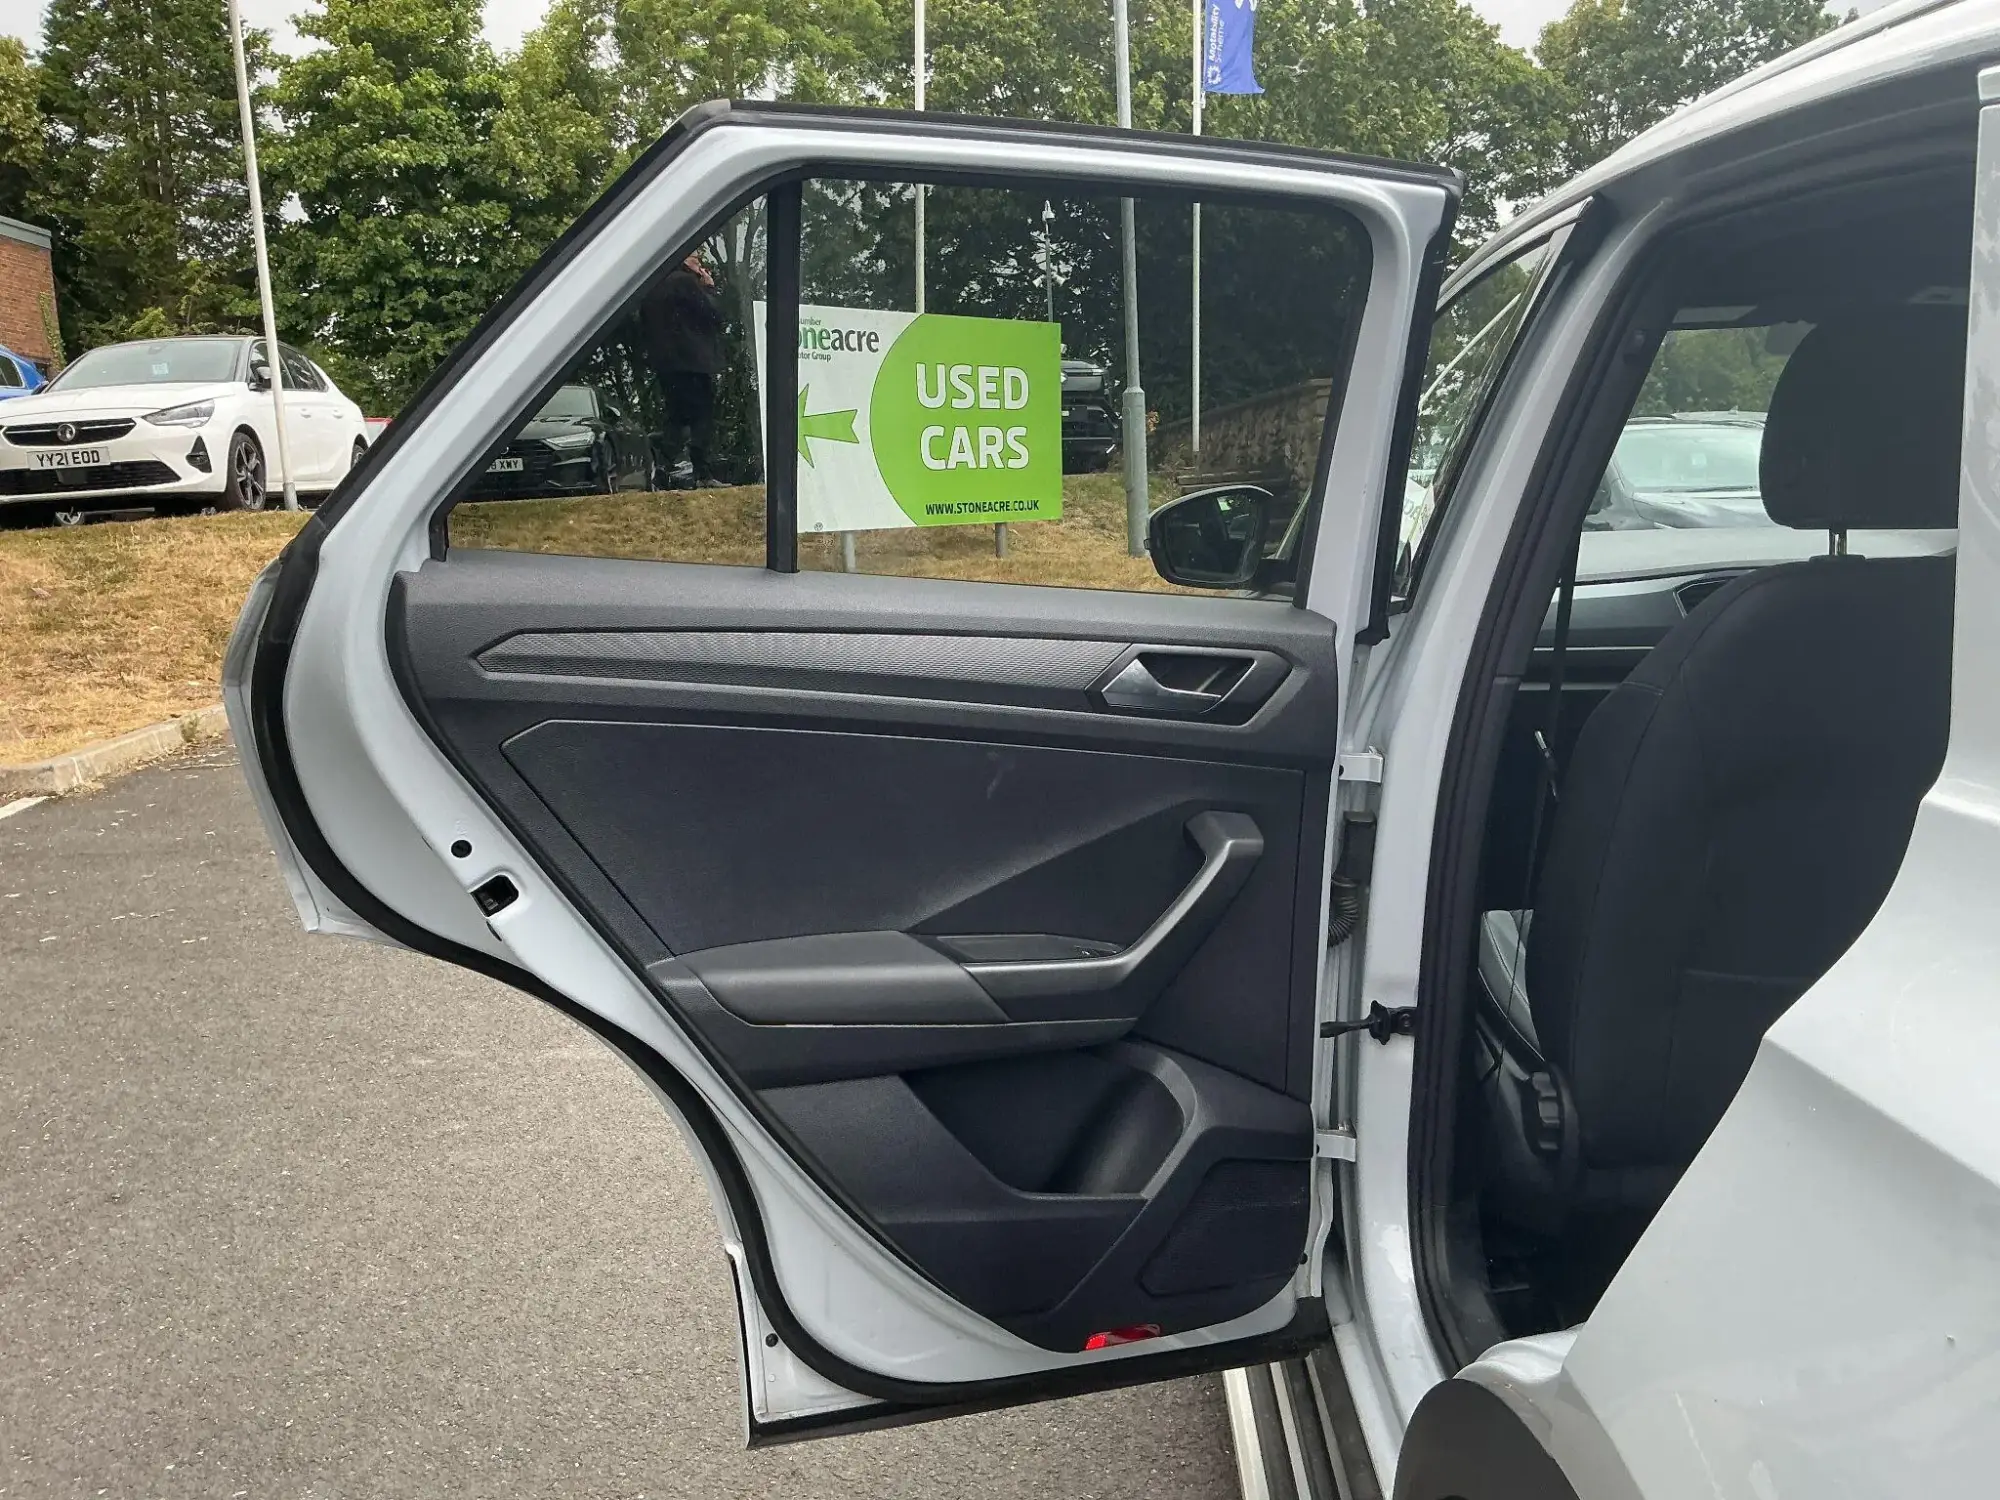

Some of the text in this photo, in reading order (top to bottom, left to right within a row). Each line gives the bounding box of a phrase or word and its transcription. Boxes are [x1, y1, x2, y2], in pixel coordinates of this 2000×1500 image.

[1208, 3, 1220, 62] Motability
[811, 351, 832, 363] Group
[915, 362, 1029, 410] USED
[36, 452, 69, 467] YY21
[919, 425, 1029, 471] CARS
[925, 499, 1040, 516] WWW.STONEACRE.CO.UK
